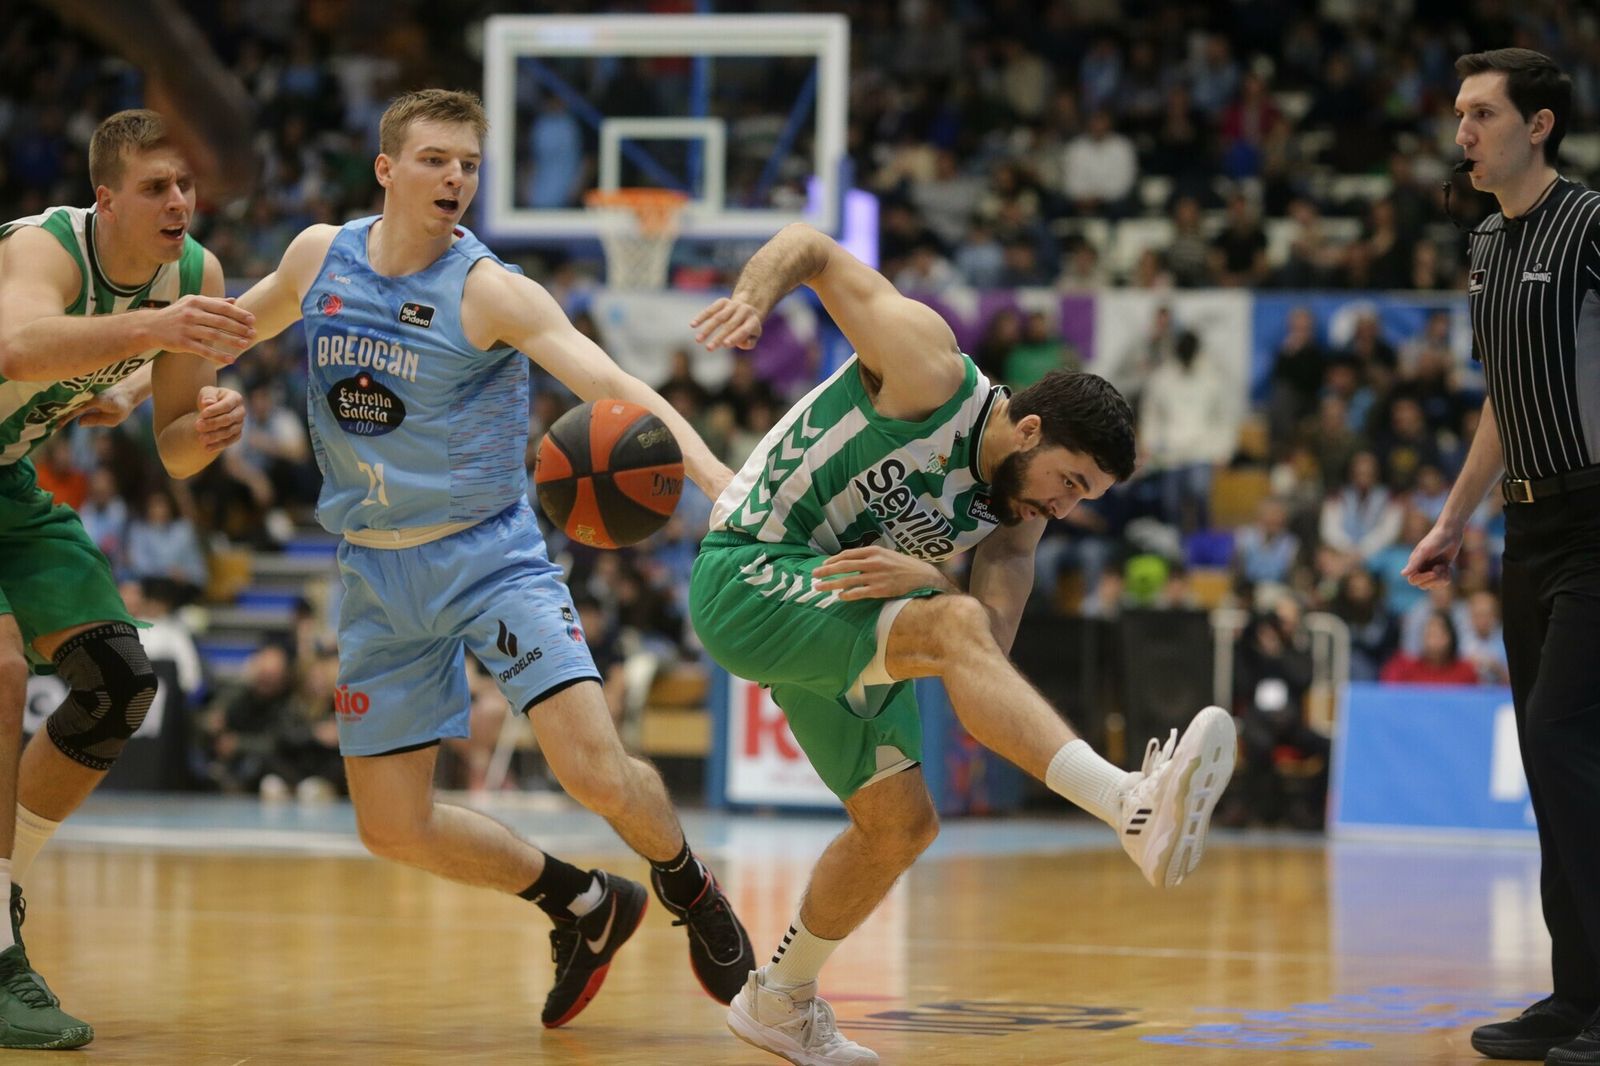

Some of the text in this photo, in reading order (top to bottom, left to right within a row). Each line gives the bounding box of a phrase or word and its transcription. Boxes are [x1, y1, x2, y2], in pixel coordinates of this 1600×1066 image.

[1521, 271, 1552, 283] SPALDING
[338, 387, 392, 409] Estrella
[339, 402, 388, 423] Galicia
[866, 458, 955, 559] Sevilla
